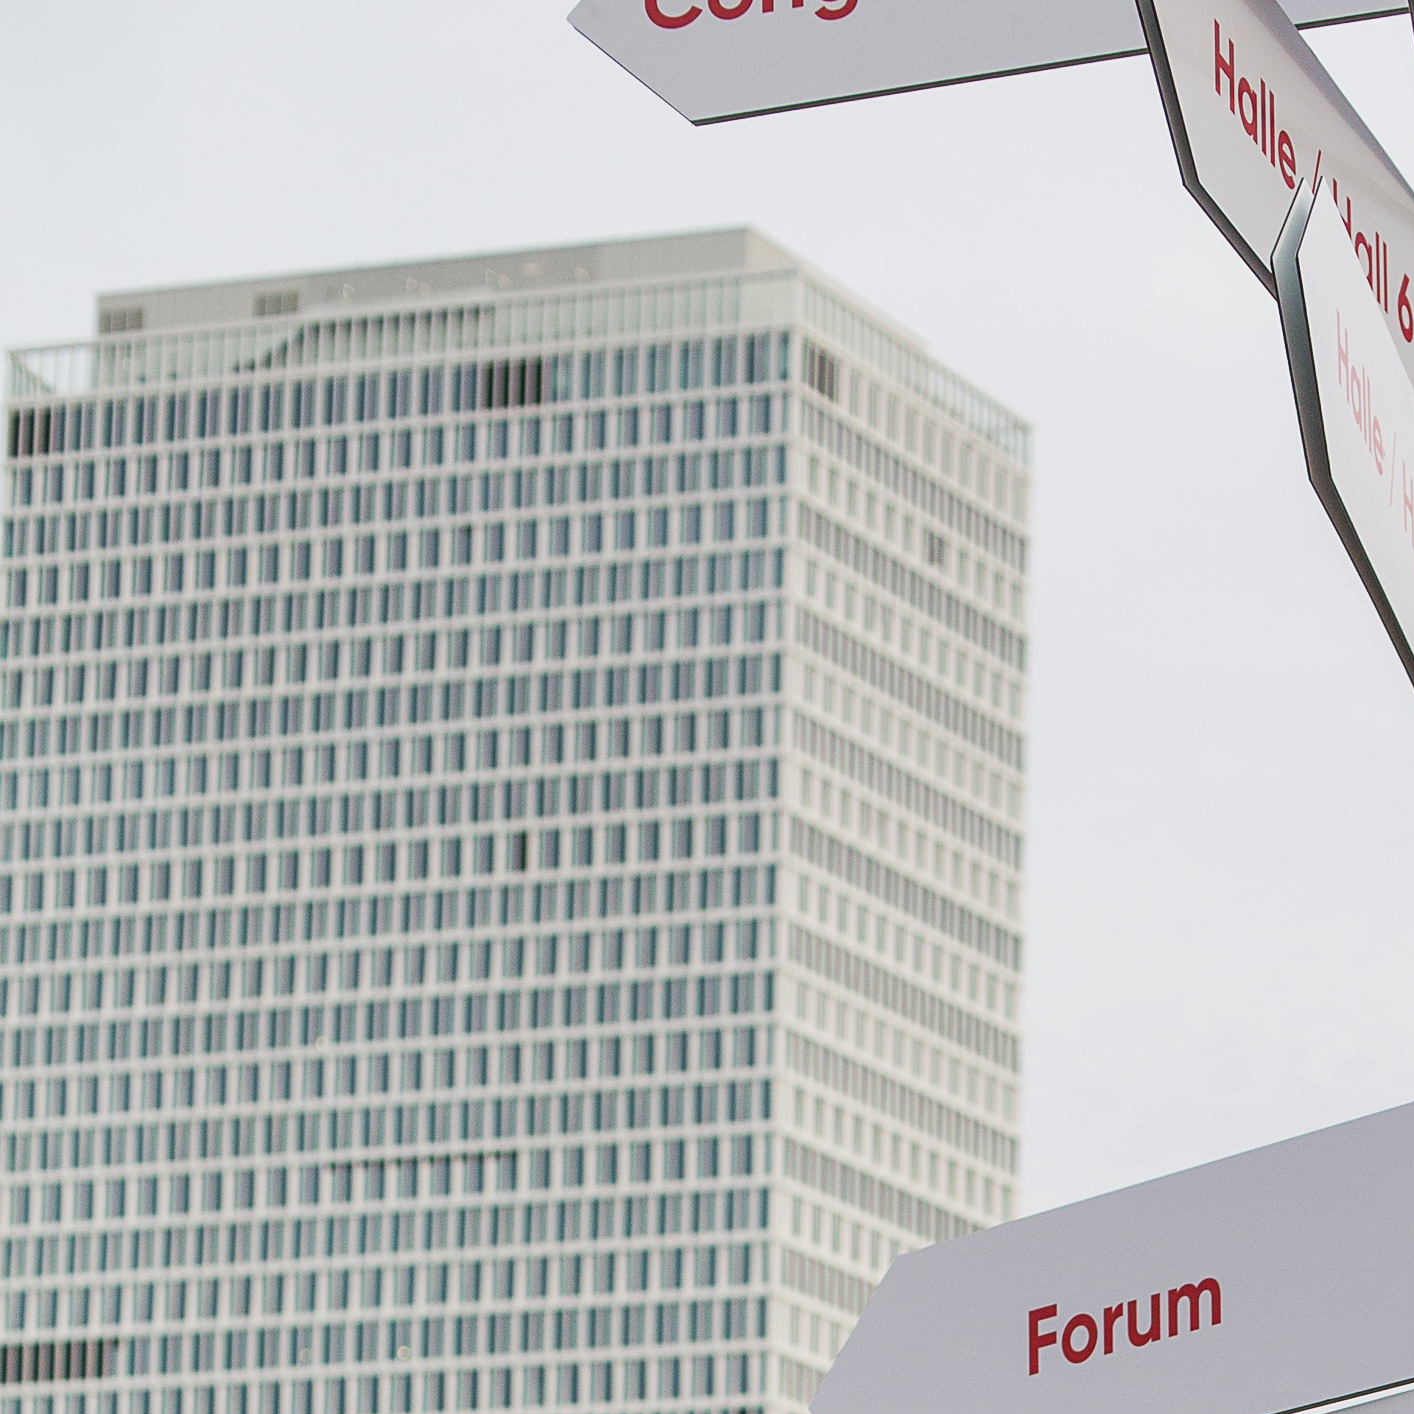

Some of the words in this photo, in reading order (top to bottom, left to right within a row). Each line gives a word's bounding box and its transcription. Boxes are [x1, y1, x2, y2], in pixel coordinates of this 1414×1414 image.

[1213, 18, 1297, 191] Halle
[1397, 273, 1414, 344] 6
[1336, 309, 1385, 476] Halle
[1028, 1276, 1222, 1376] Forum
